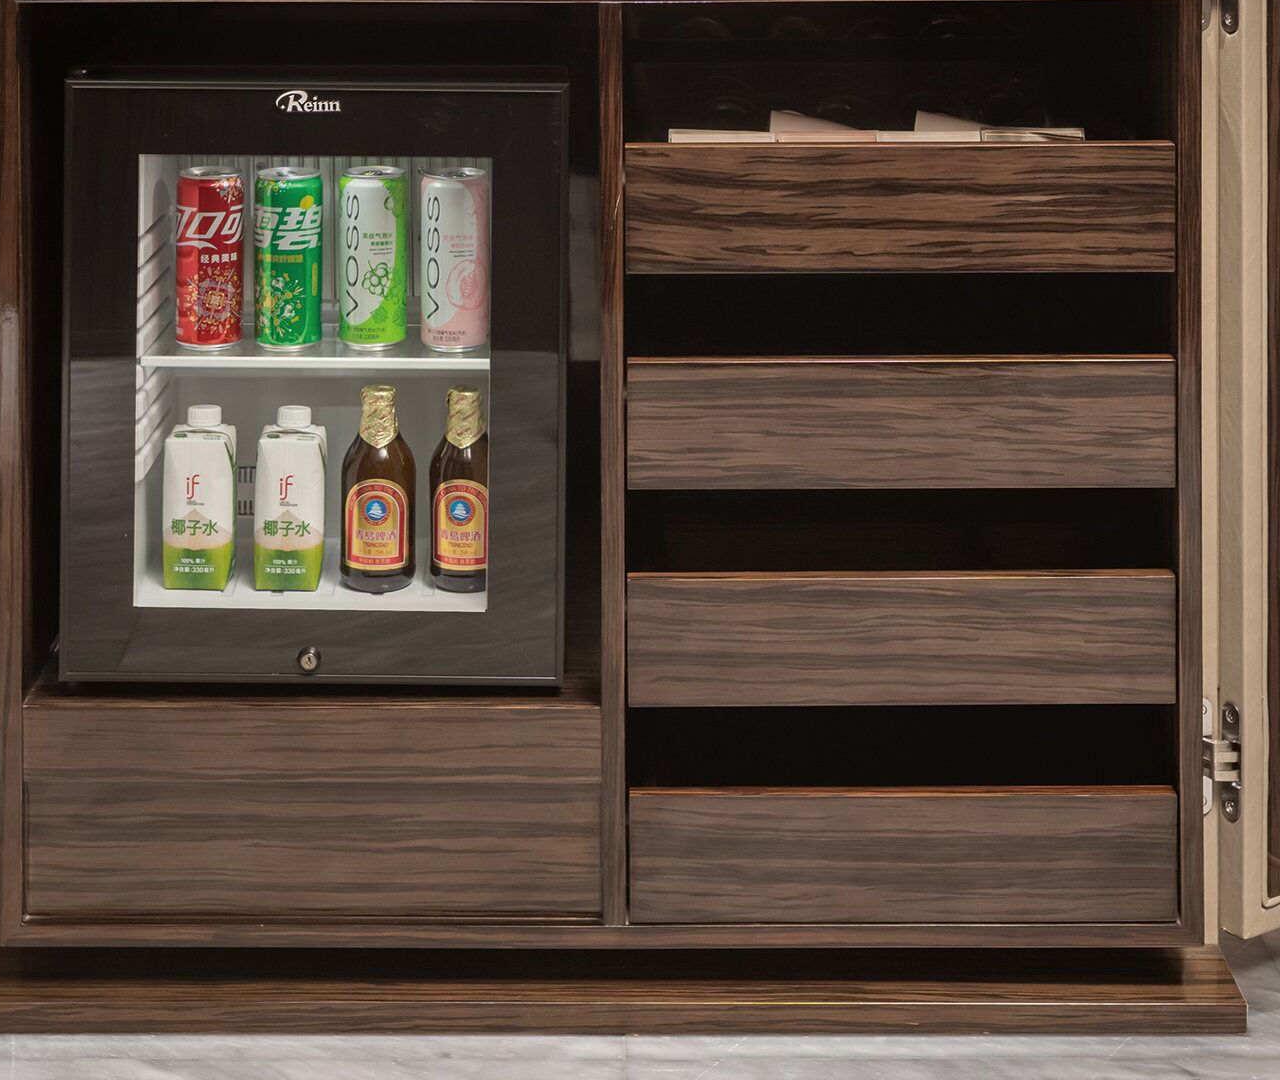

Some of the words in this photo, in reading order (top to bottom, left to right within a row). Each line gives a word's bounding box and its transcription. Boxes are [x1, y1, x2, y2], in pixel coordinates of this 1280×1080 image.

[275, 90, 341, 112] Reinn
[200, 252, 238, 263] 经典美味
[346, 194, 360, 318] VOSS
[427, 195, 441, 320] VOSS
[186, 474, 200, 500] if
[279, 475, 294, 500] if
[171, 519, 219, 536] 椰子水
[263, 520, 311, 537] 椰子水
